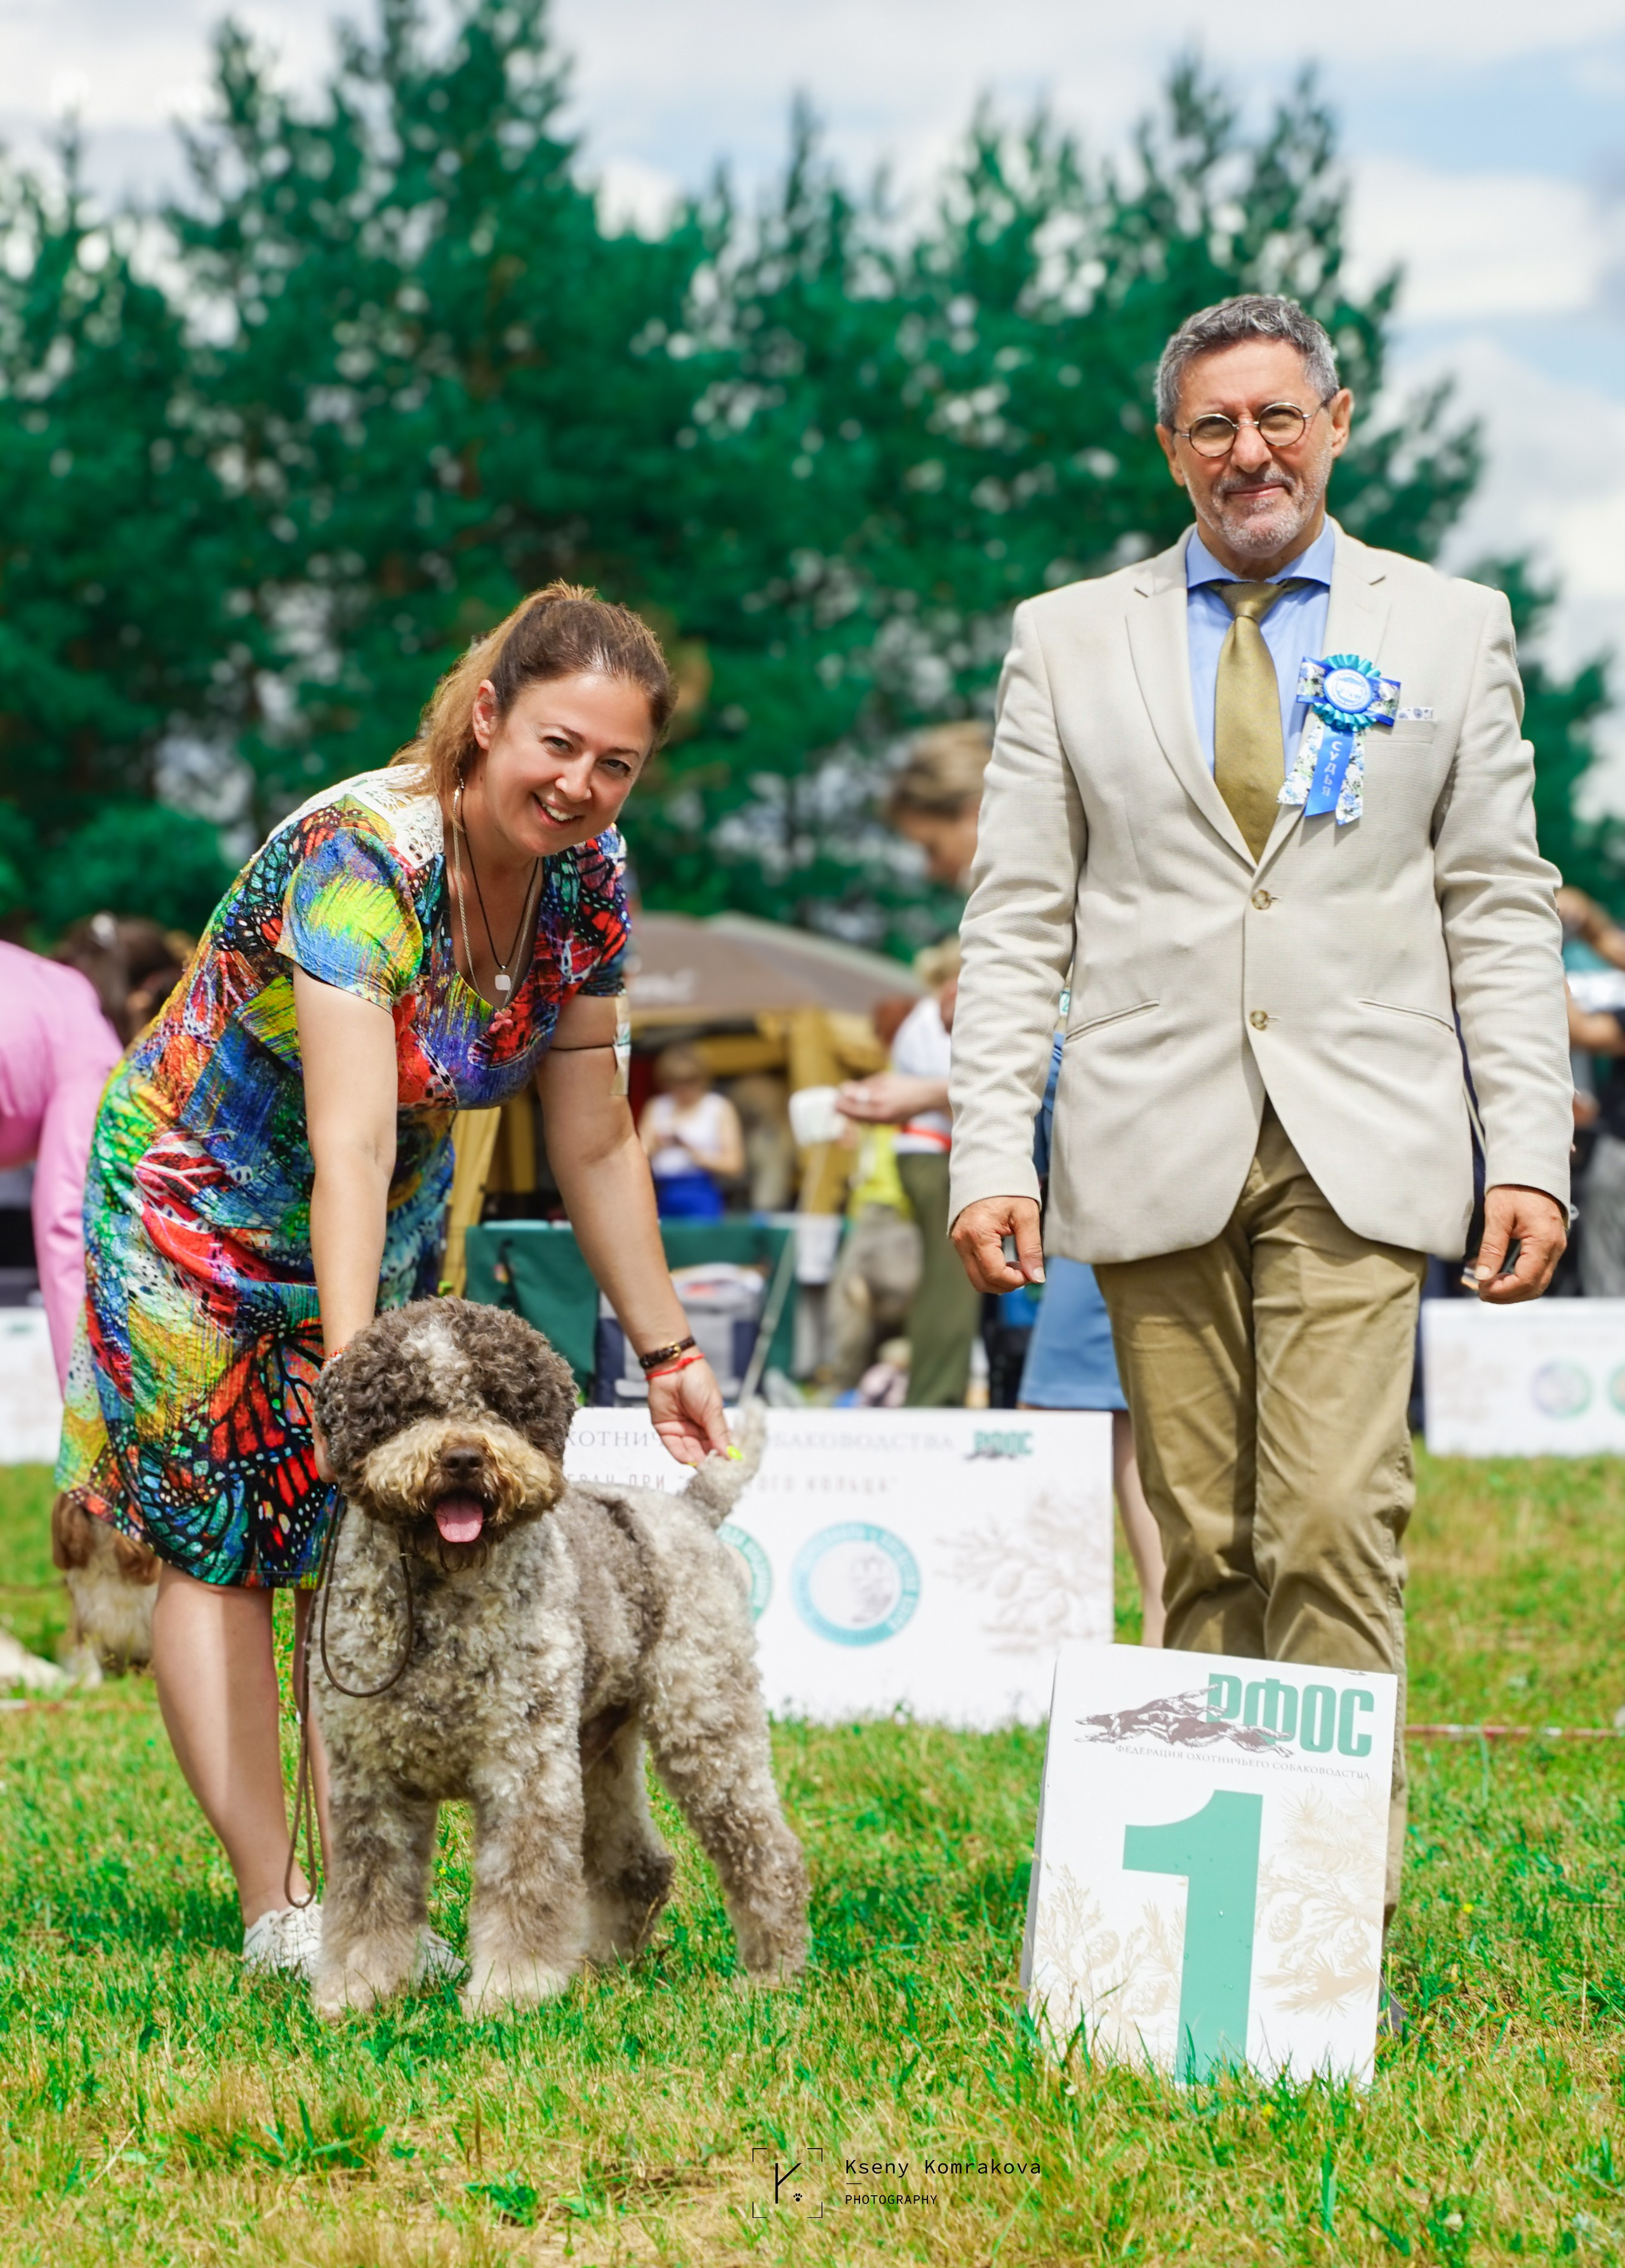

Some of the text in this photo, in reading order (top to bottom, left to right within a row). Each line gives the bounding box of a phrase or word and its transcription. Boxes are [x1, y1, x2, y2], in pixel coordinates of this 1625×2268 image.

[1321, 740, 1343, 797] СУДЬЯ
[1207, 1673, 1374, 1757] РФОС
[1115, 1744, 1370, 1780] ФЕДЕРАЦИЯ ОХОТНИЧЬЕГО СОБАКОВОДСТВА
[1122, 1789, 1264, 2086] 1
